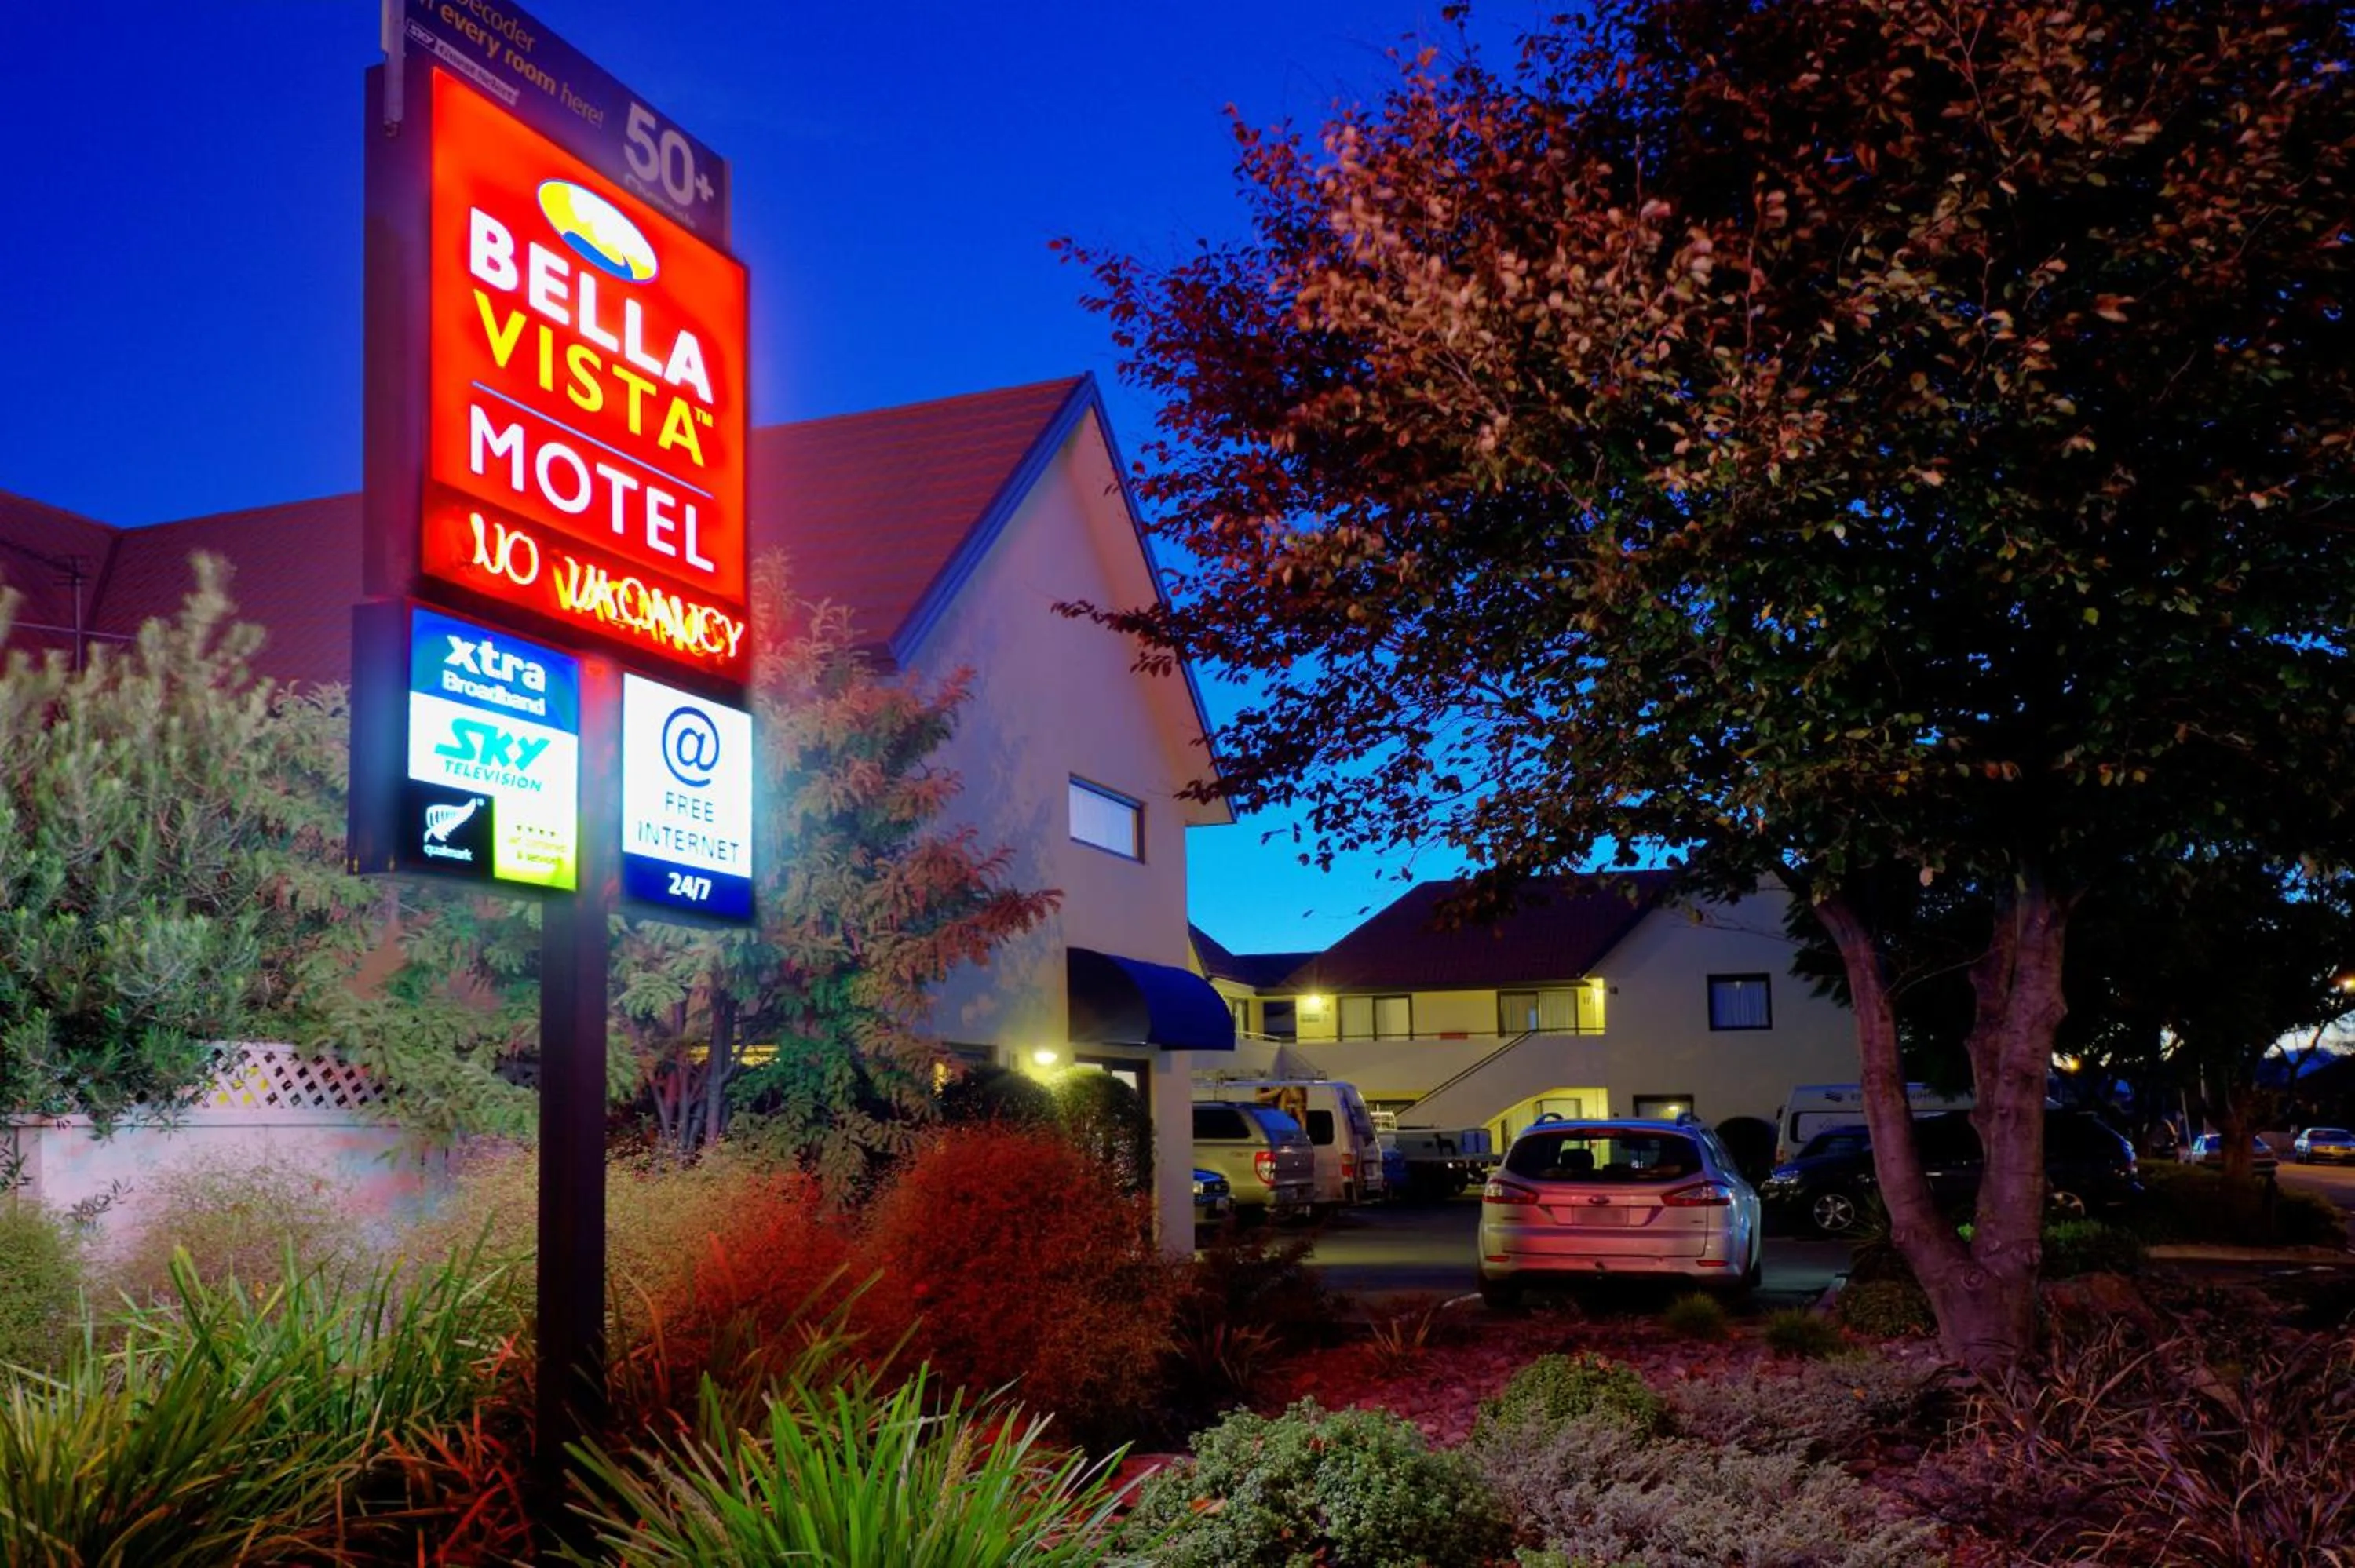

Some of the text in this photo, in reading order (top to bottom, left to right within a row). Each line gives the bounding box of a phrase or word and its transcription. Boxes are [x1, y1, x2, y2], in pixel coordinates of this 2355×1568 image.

[440, 4, 501, 59] every
[505, 49, 557, 95] room
[560, 82, 604, 129] here!
[470, 206, 714, 404] BELLA
[470, 403, 714, 572] MOTEL
[469, 512, 744, 658] NO VACANCY
[443, 635, 545, 691] xtra
[442, 670, 545, 716] Broadband
[434, 718, 551, 769] SKY
[444, 759, 543, 792] TELEVISION
[665, 790, 714, 823] FREE
[637, 821, 739, 862] INTERNET
[667, 871, 713, 902] 24/7
